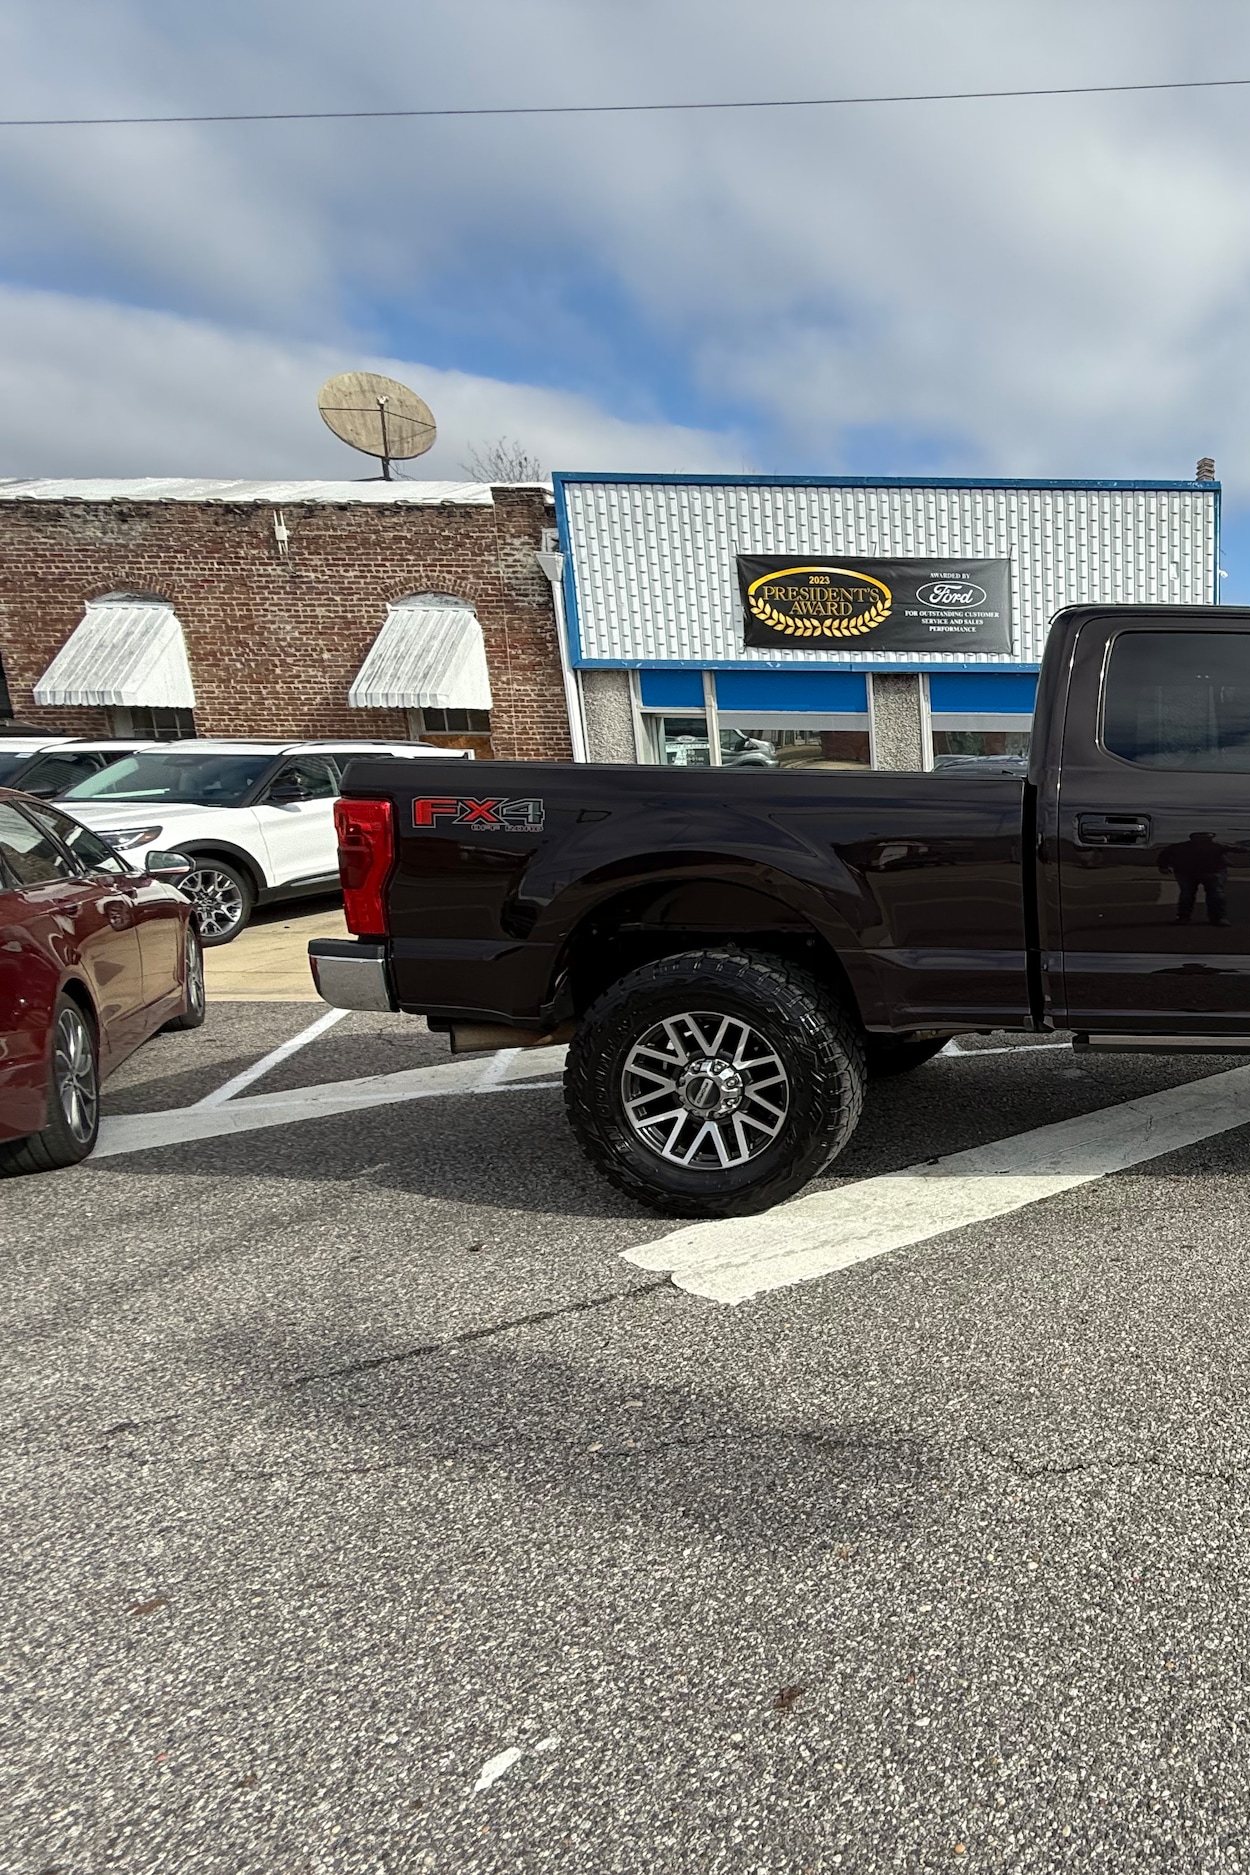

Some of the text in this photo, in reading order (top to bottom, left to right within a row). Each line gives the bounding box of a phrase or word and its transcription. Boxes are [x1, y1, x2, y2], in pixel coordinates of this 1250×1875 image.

[808, 575, 831, 585] 2023
[762, 585, 881, 602] PRESIDENT'S
[929, 584, 974, 604] Ford
[789, 600, 853, 616] AWARD
[412, 796, 546, 829] FX4
